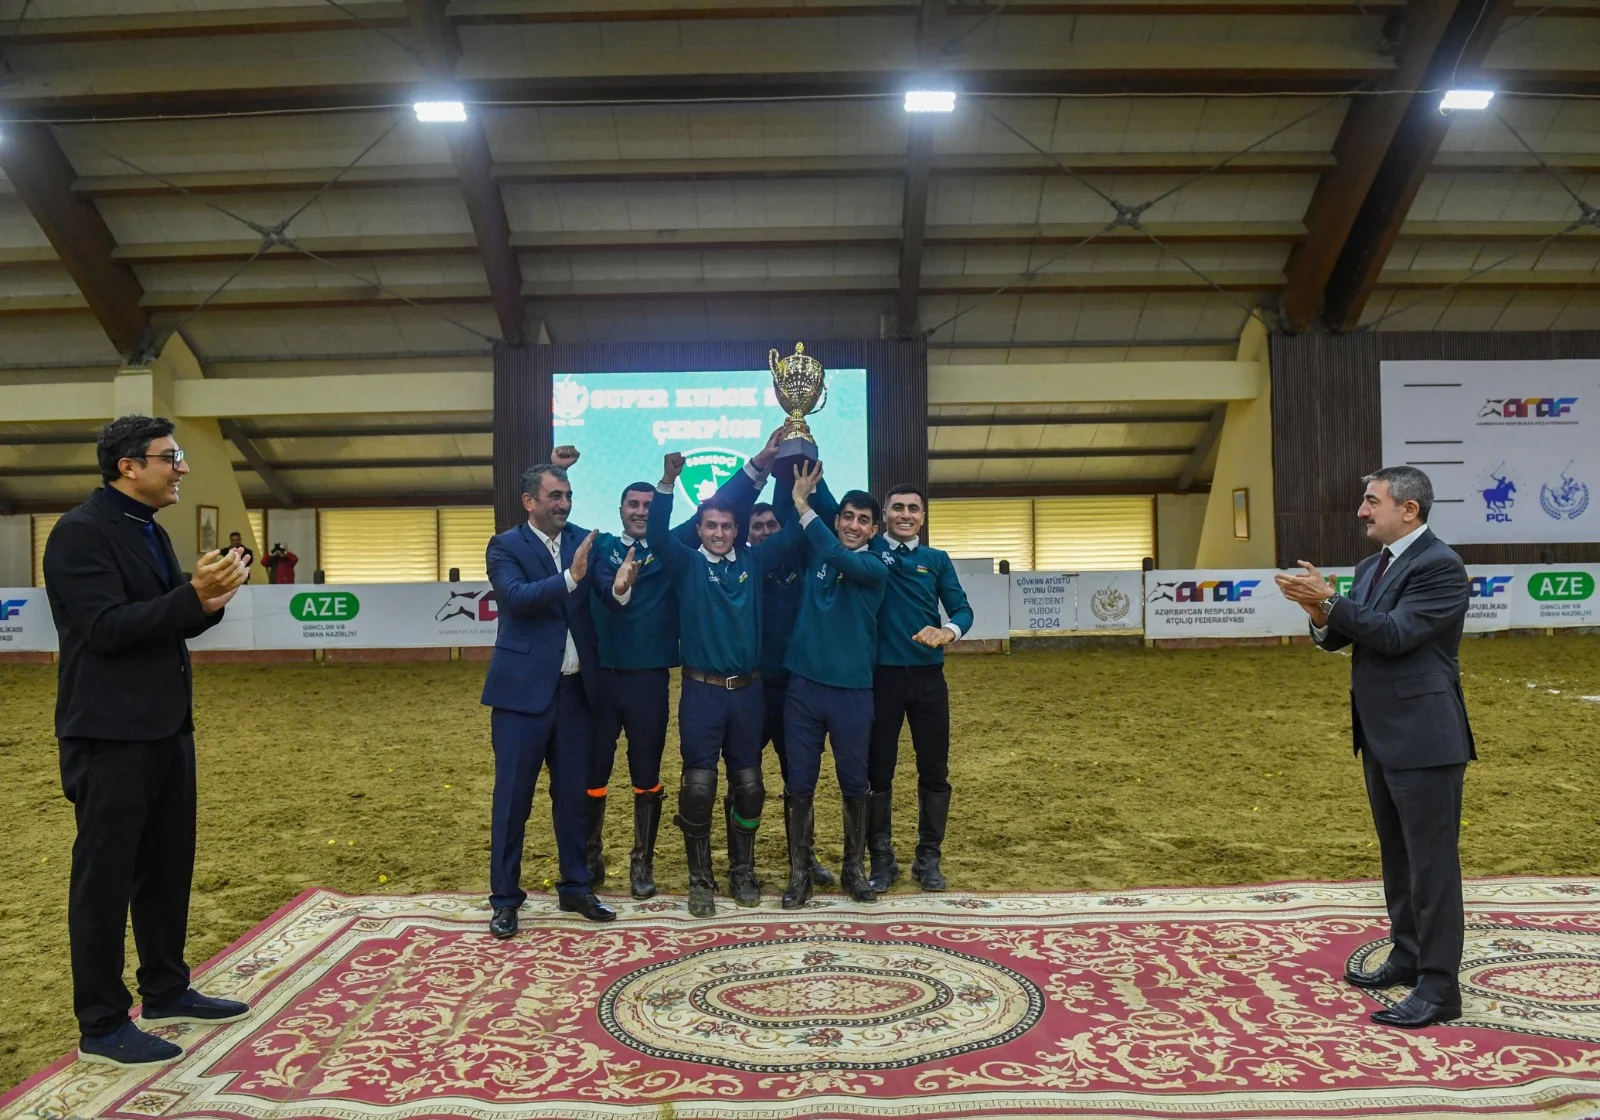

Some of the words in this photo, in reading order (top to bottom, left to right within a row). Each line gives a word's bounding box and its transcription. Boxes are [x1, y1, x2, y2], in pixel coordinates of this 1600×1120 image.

[1539, 576, 1583, 596] AZE
[302, 597, 347, 616] AZE
[1028, 607, 1061, 615] KUBOKU
[1029, 617, 1061, 629] 2024
